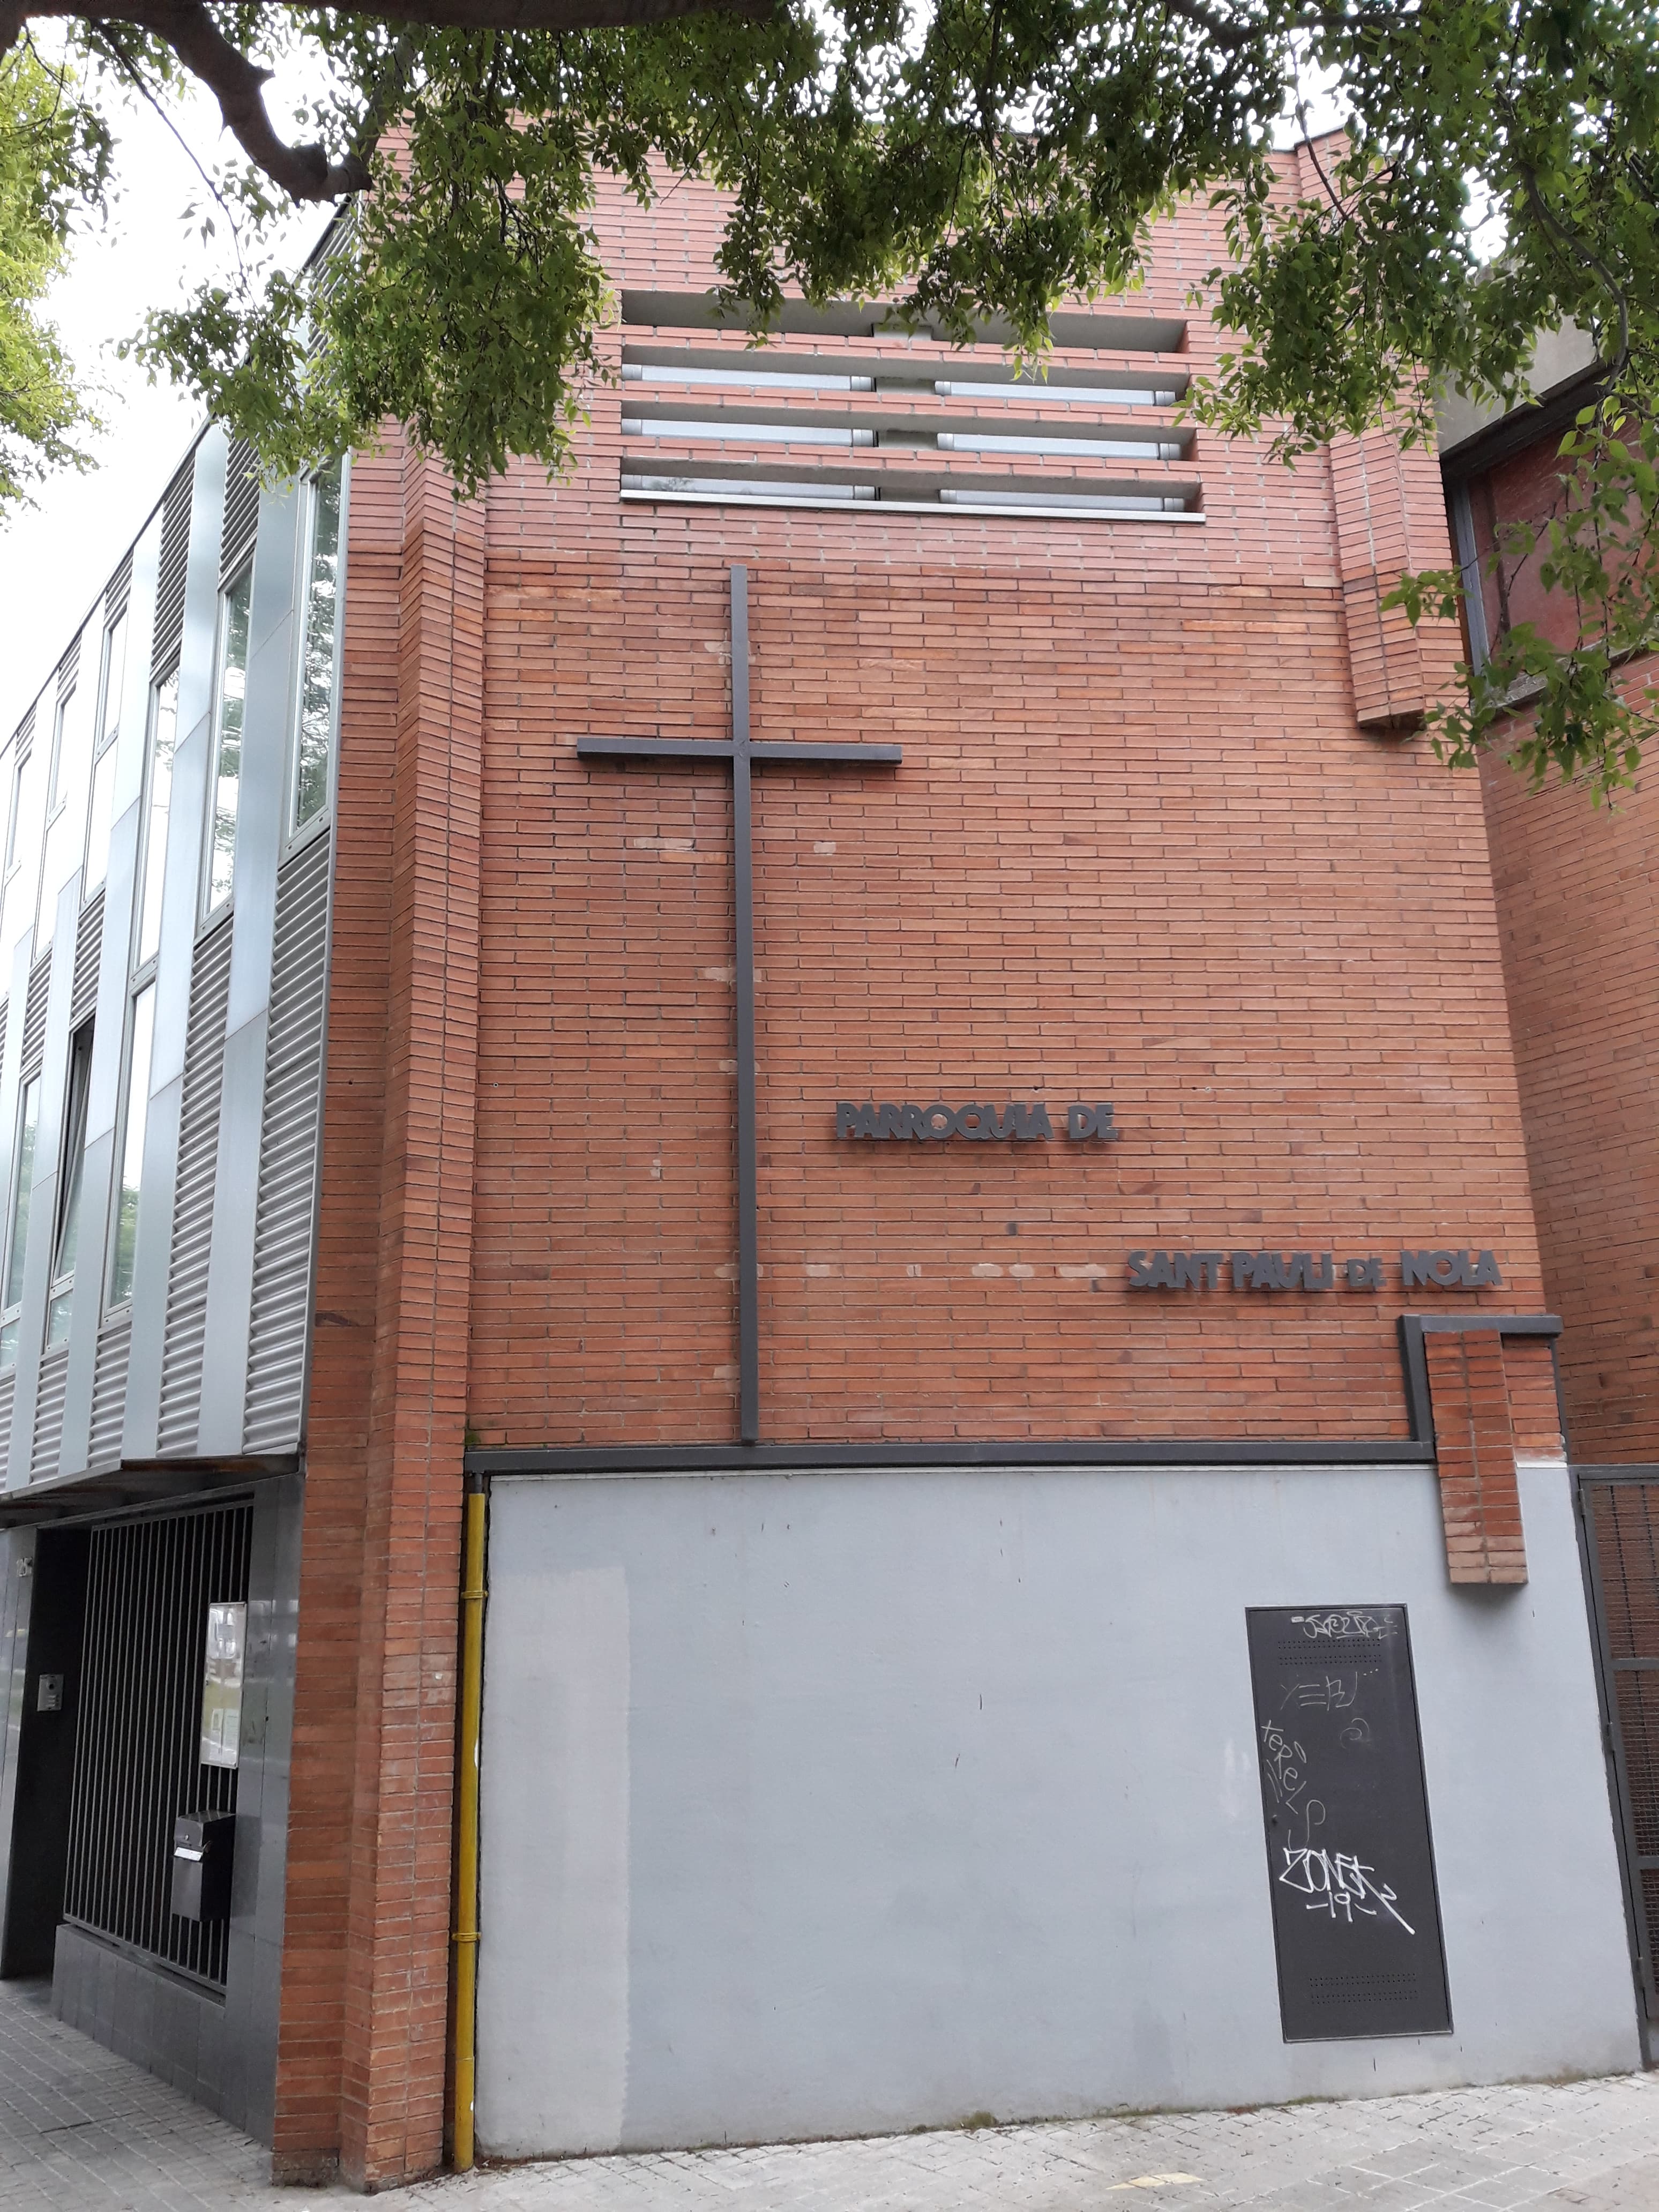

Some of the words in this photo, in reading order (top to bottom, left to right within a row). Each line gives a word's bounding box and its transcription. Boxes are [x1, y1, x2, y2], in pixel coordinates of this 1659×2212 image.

[836, 1102, 1054, 1141] PARROQUIA
[1068, 1102, 1118, 1140] DE
[1128, 1251, 1223, 1289] SANT
[1232, 1251, 1333, 1290] PAULI
[1346, 1257, 1387, 1287] DE
[1400, 1249, 1504, 1287] NOLA
